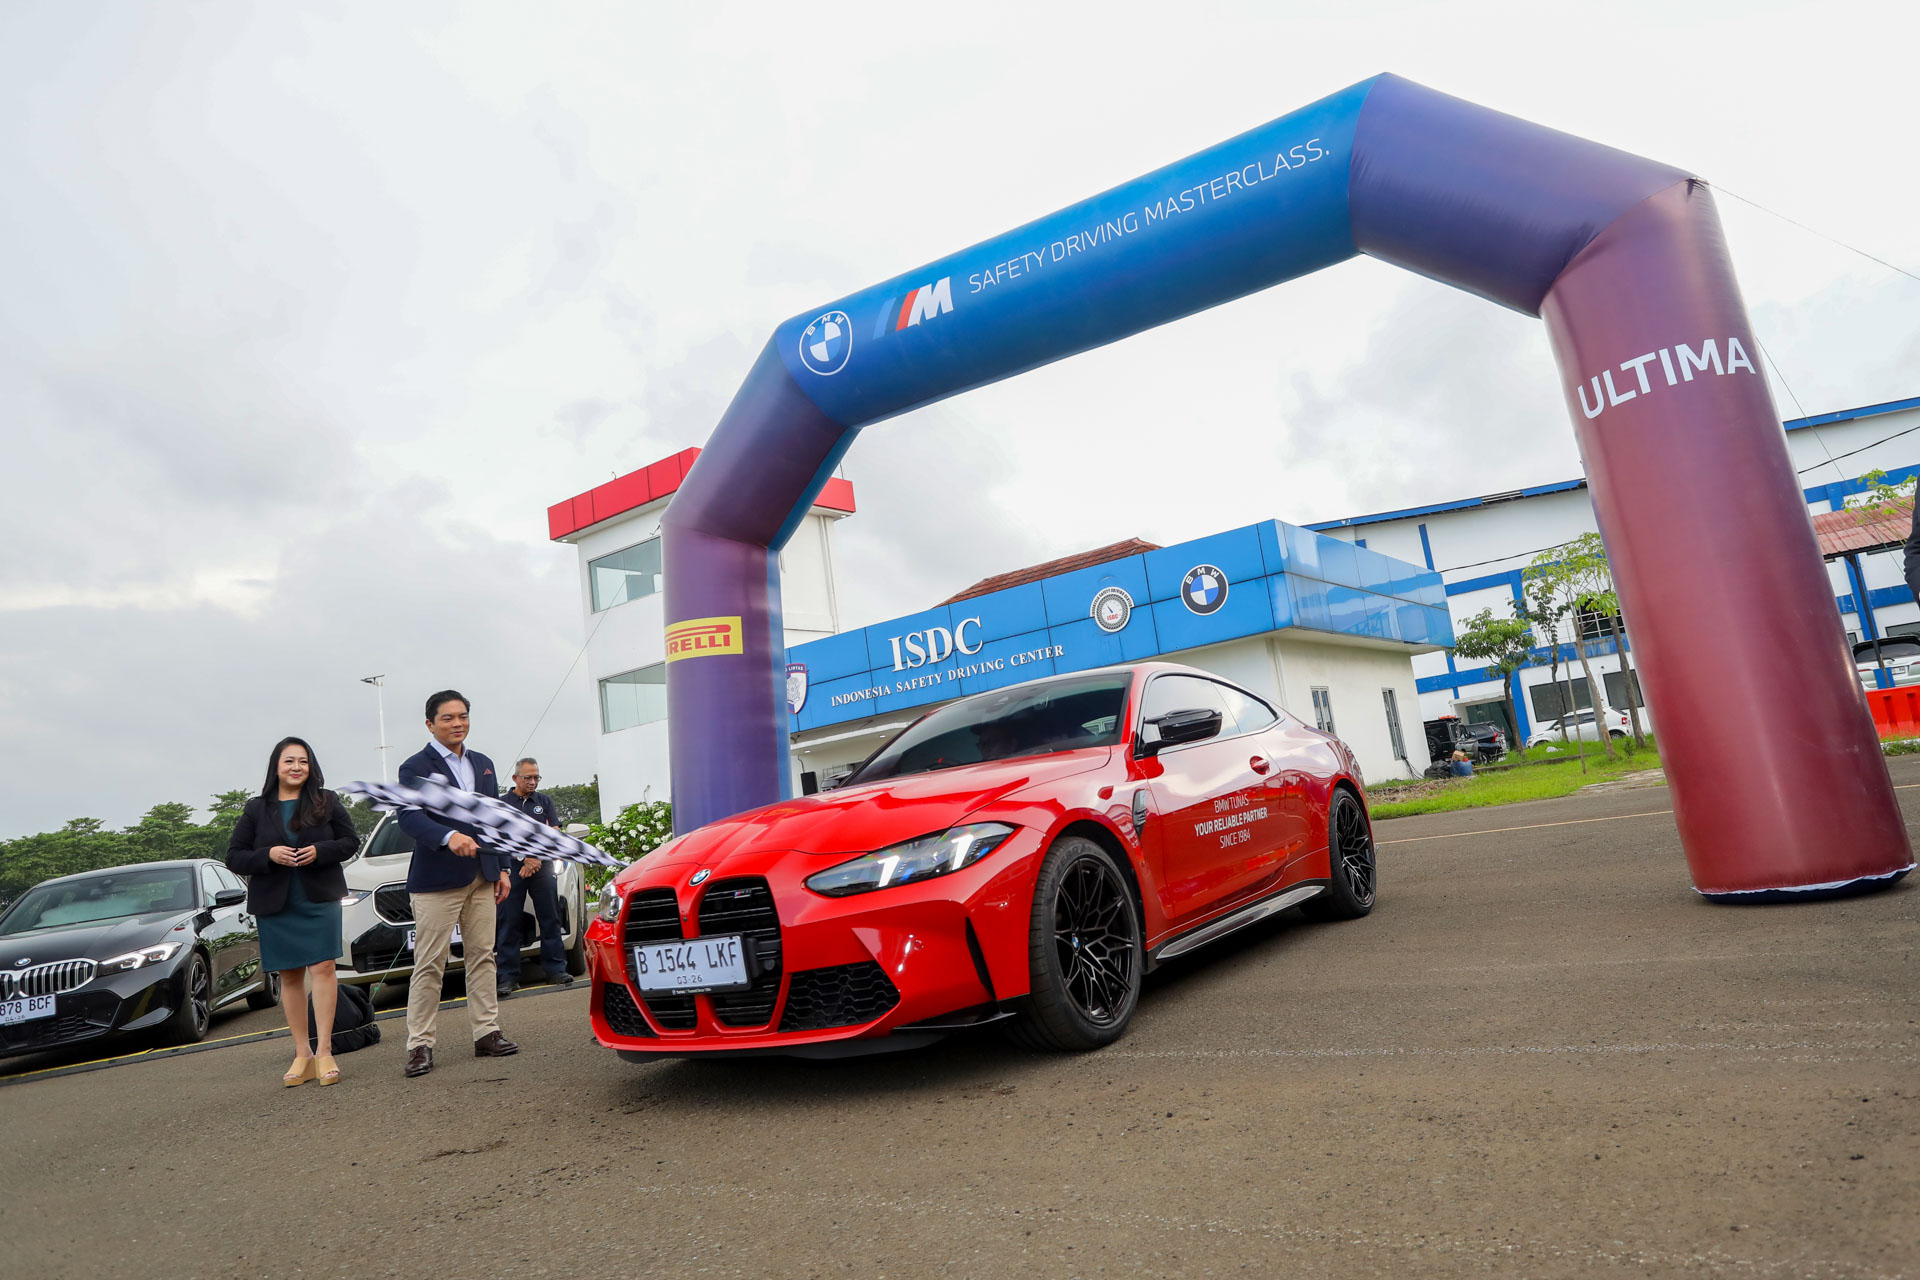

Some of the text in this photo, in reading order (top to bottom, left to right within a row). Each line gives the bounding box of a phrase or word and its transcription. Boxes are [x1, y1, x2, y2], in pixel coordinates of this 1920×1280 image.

[968, 138, 1330, 294] SAFETY DRIVING MASTERCLASS.
[806, 314, 845, 337] BMW
[1577, 337, 1757, 420] ULTIMA
[1185, 567, 1220, 585] BMW
[666, 634, 731, 657] IRELLI
[888, 615, 984, 672] ISDC
[831, 645, 1064, 707] INDONESIA SAFETY DRIVING CENTER
[1213, 793, 1250, 814] BMW TUNAS
[1194, 806, 1269, 837] YOUR RELIABLE PARTNER
[1220, 828, 1251, 849] SINCE 1984
[637, 941, 737, 975] B 1544 LKF
[29, 995, 52, 1012] BCF
